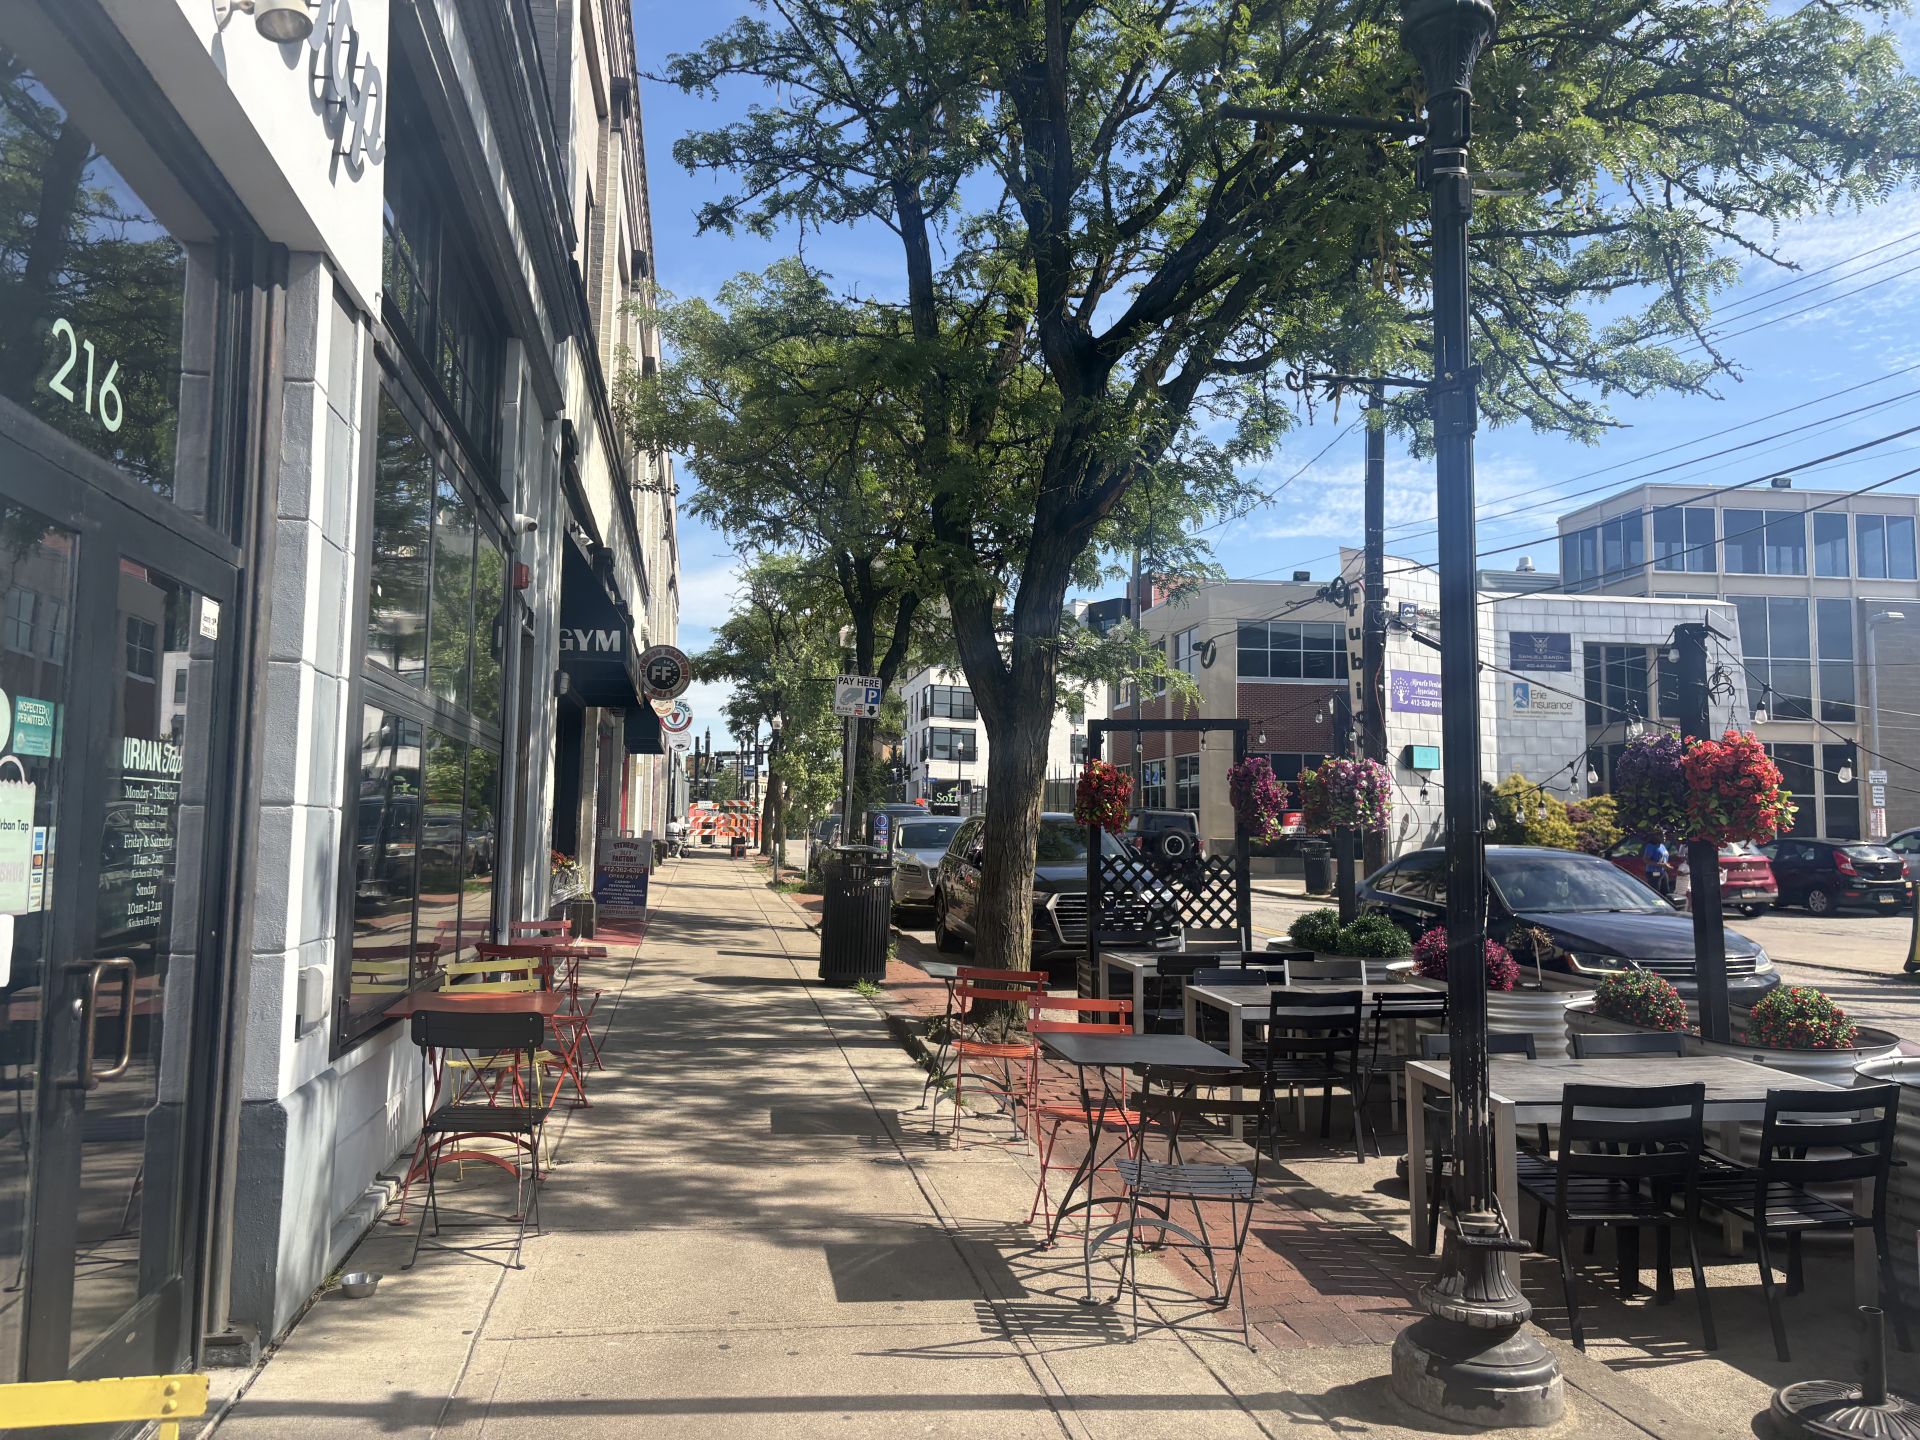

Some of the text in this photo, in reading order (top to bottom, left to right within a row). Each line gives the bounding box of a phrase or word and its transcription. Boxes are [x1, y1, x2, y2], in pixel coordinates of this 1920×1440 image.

[48, 317, 123, 432] 216
[559, 628, 620, 652] GYM
[651, 665, 672, 680] FF
[838, 676, 880, 688] PAY HERE
[1530, 689, 1547, 700] Erie
[17, 701, 46, 716] INSPECTED
[1530, 701, 1573, 710] Insurance
[123, 736, 184, 779] URBAN Tap
[125, 785, 149, 803] Monday
[0, 819, 29, 834] rban Tap
[124, 833, 143, 852] Friday
[150, 833, 174, 849] Saturday
[136, 881, 157, 898] Sunday
